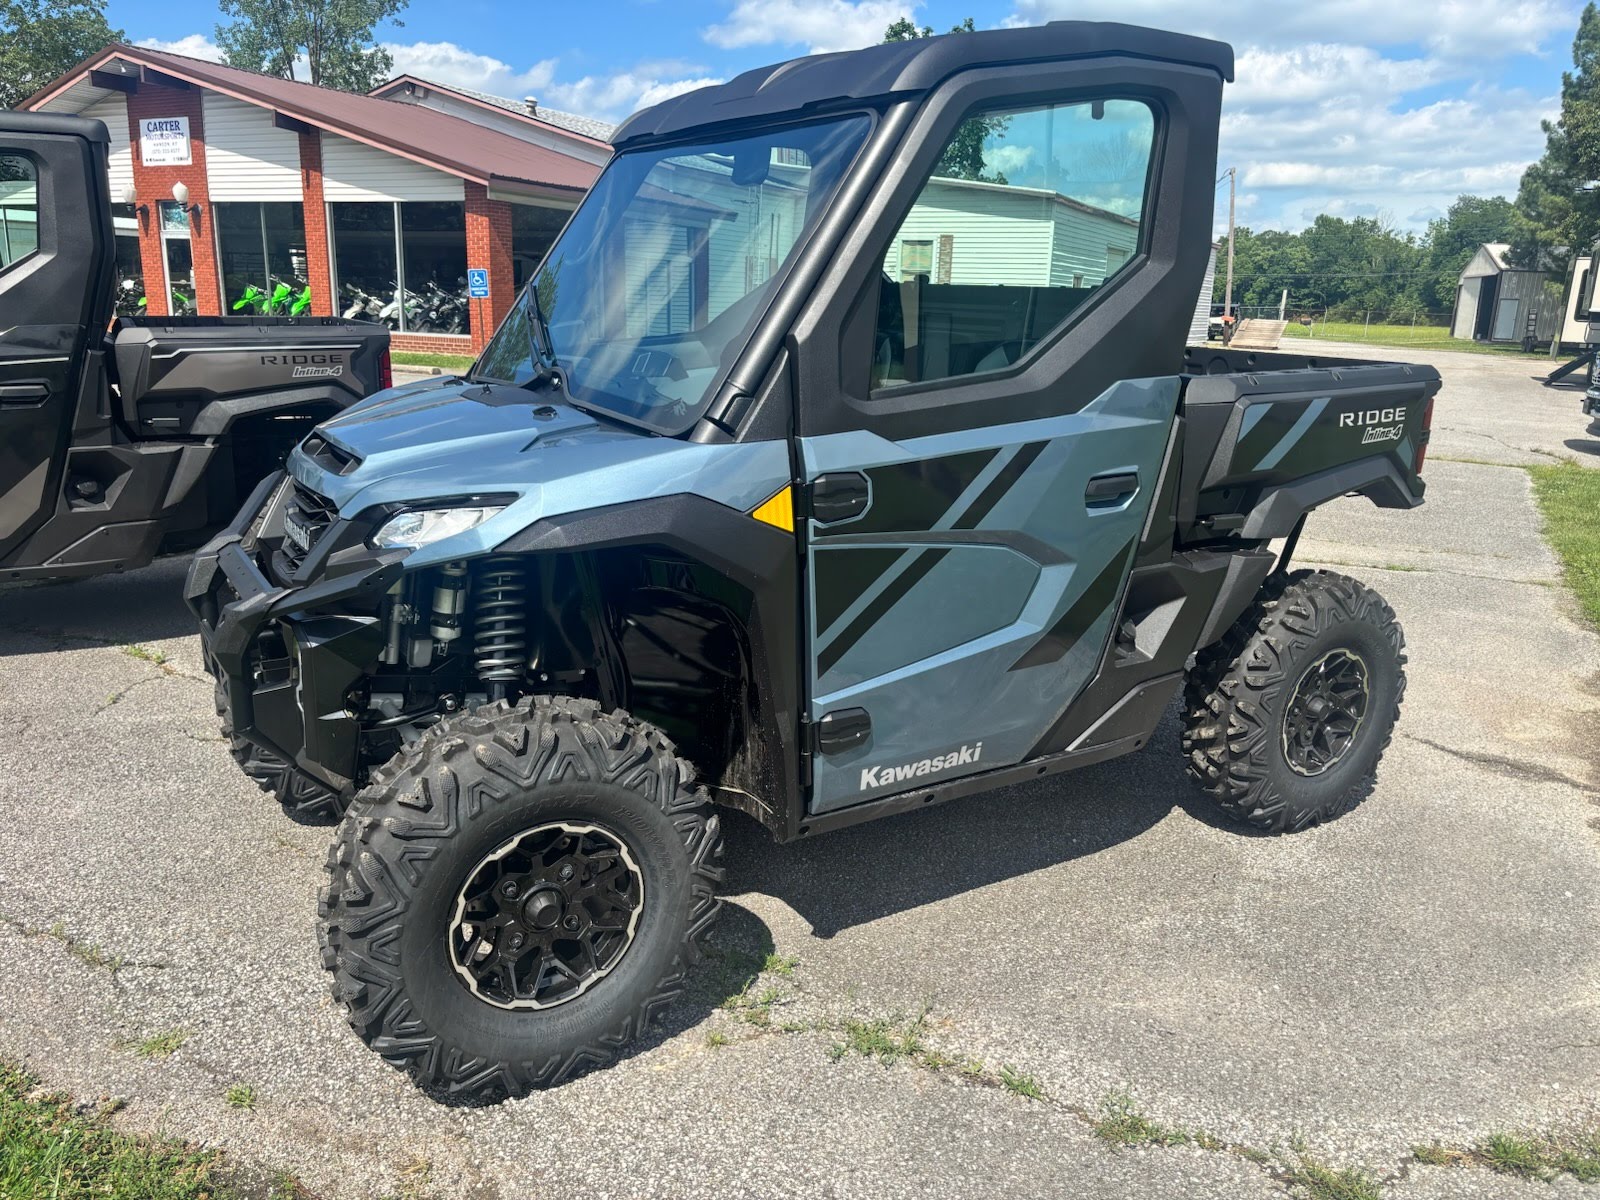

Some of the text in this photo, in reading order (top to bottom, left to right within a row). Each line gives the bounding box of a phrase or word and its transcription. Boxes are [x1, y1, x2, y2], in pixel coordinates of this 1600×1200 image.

[147, 121, 180, 132] CARTER
[261, 354, 343, 365] RIDGE
[1339, 407, 1406, 427] RIDGE
[860, 742, 983, 791] Kawasaki
